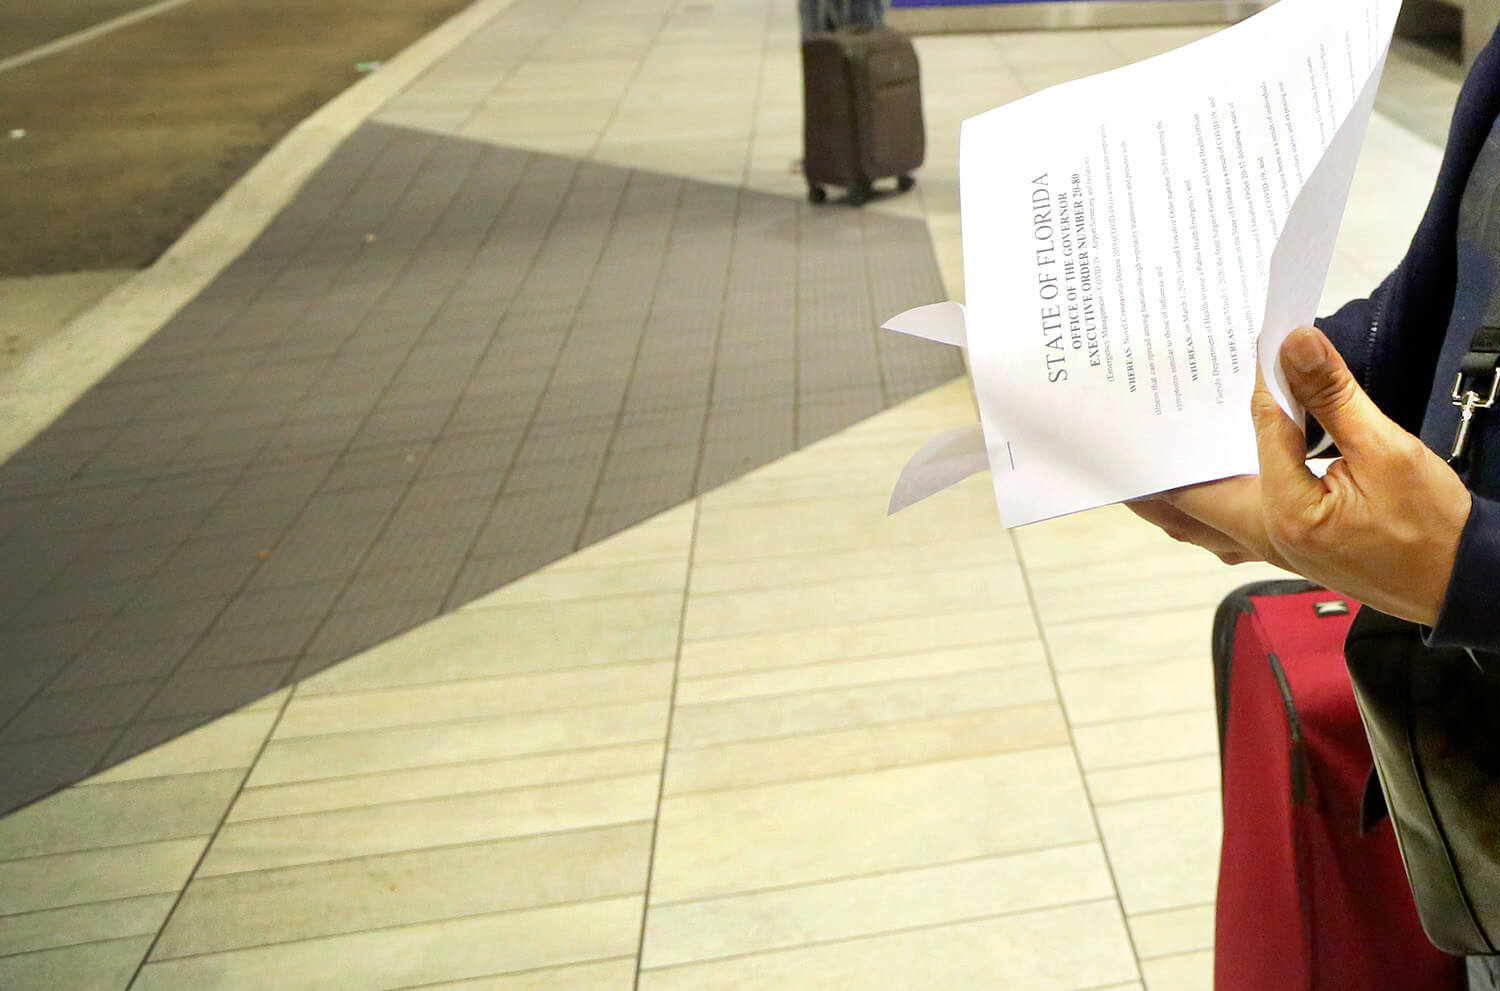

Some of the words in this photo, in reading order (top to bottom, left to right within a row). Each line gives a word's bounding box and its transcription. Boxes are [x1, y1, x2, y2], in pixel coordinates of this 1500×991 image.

[1071, 173, 1082, 198] 20-80
[1031, 173, 1055, 266] FLORIDA
[1057, 192, 1073, 257] GOVERNOR
[1073, 200, 1087, 249] NUMBER
[1038, 273, 1059, 300] OF
[1063, 259, 1076, 282] THE
[1066, 285, 1077, 301] OF
[1078, 251, 1091, 292] ORDER
[1041, 305, 1068, 383] STATE
[1068, 303, 1082, 350] OFFICE
[1082, 294, 1101, 367] EXECUTIVE
